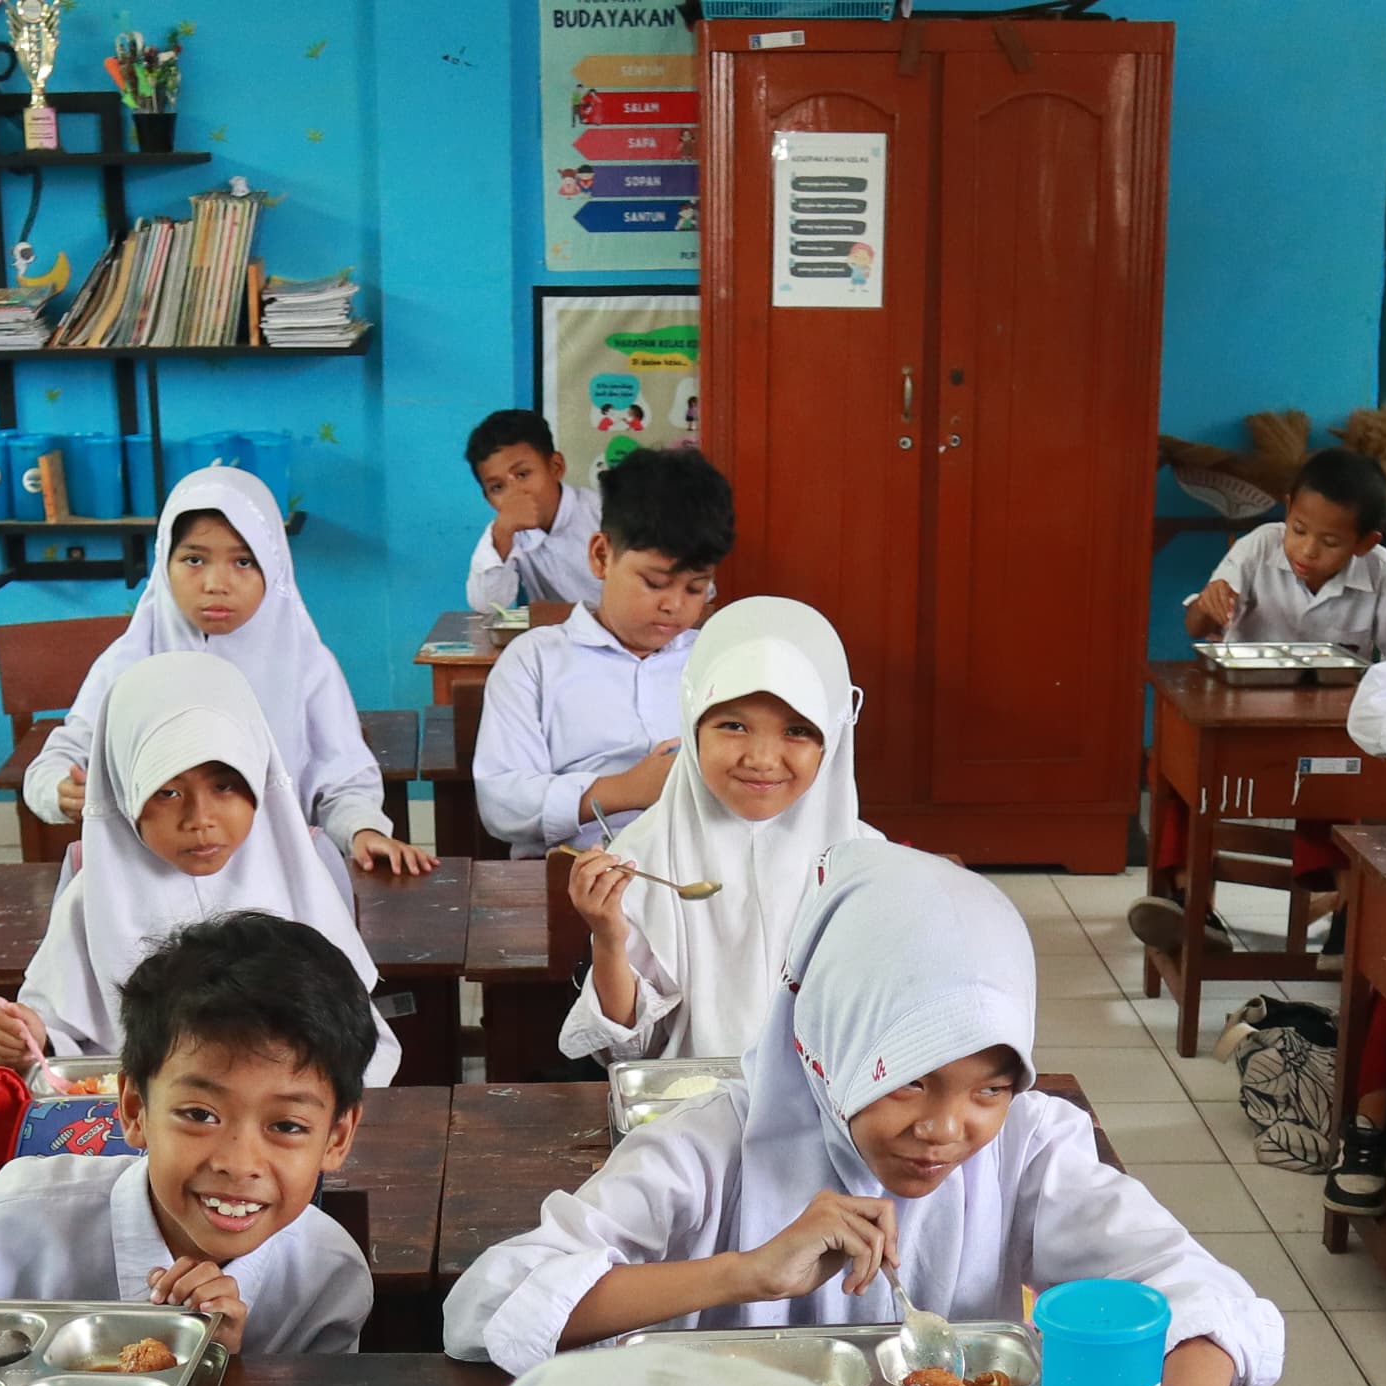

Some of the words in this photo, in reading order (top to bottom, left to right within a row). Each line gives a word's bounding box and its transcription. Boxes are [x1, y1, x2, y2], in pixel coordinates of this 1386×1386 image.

[553, 9, 675, 28] BUDAYAKAN
[623, 102, 660, 113] SALAM
[628, 138, 656, 148] SAPA
[625, 176, 661, 187] SOPAN
[623, 211, 666, 223] SANTUN
